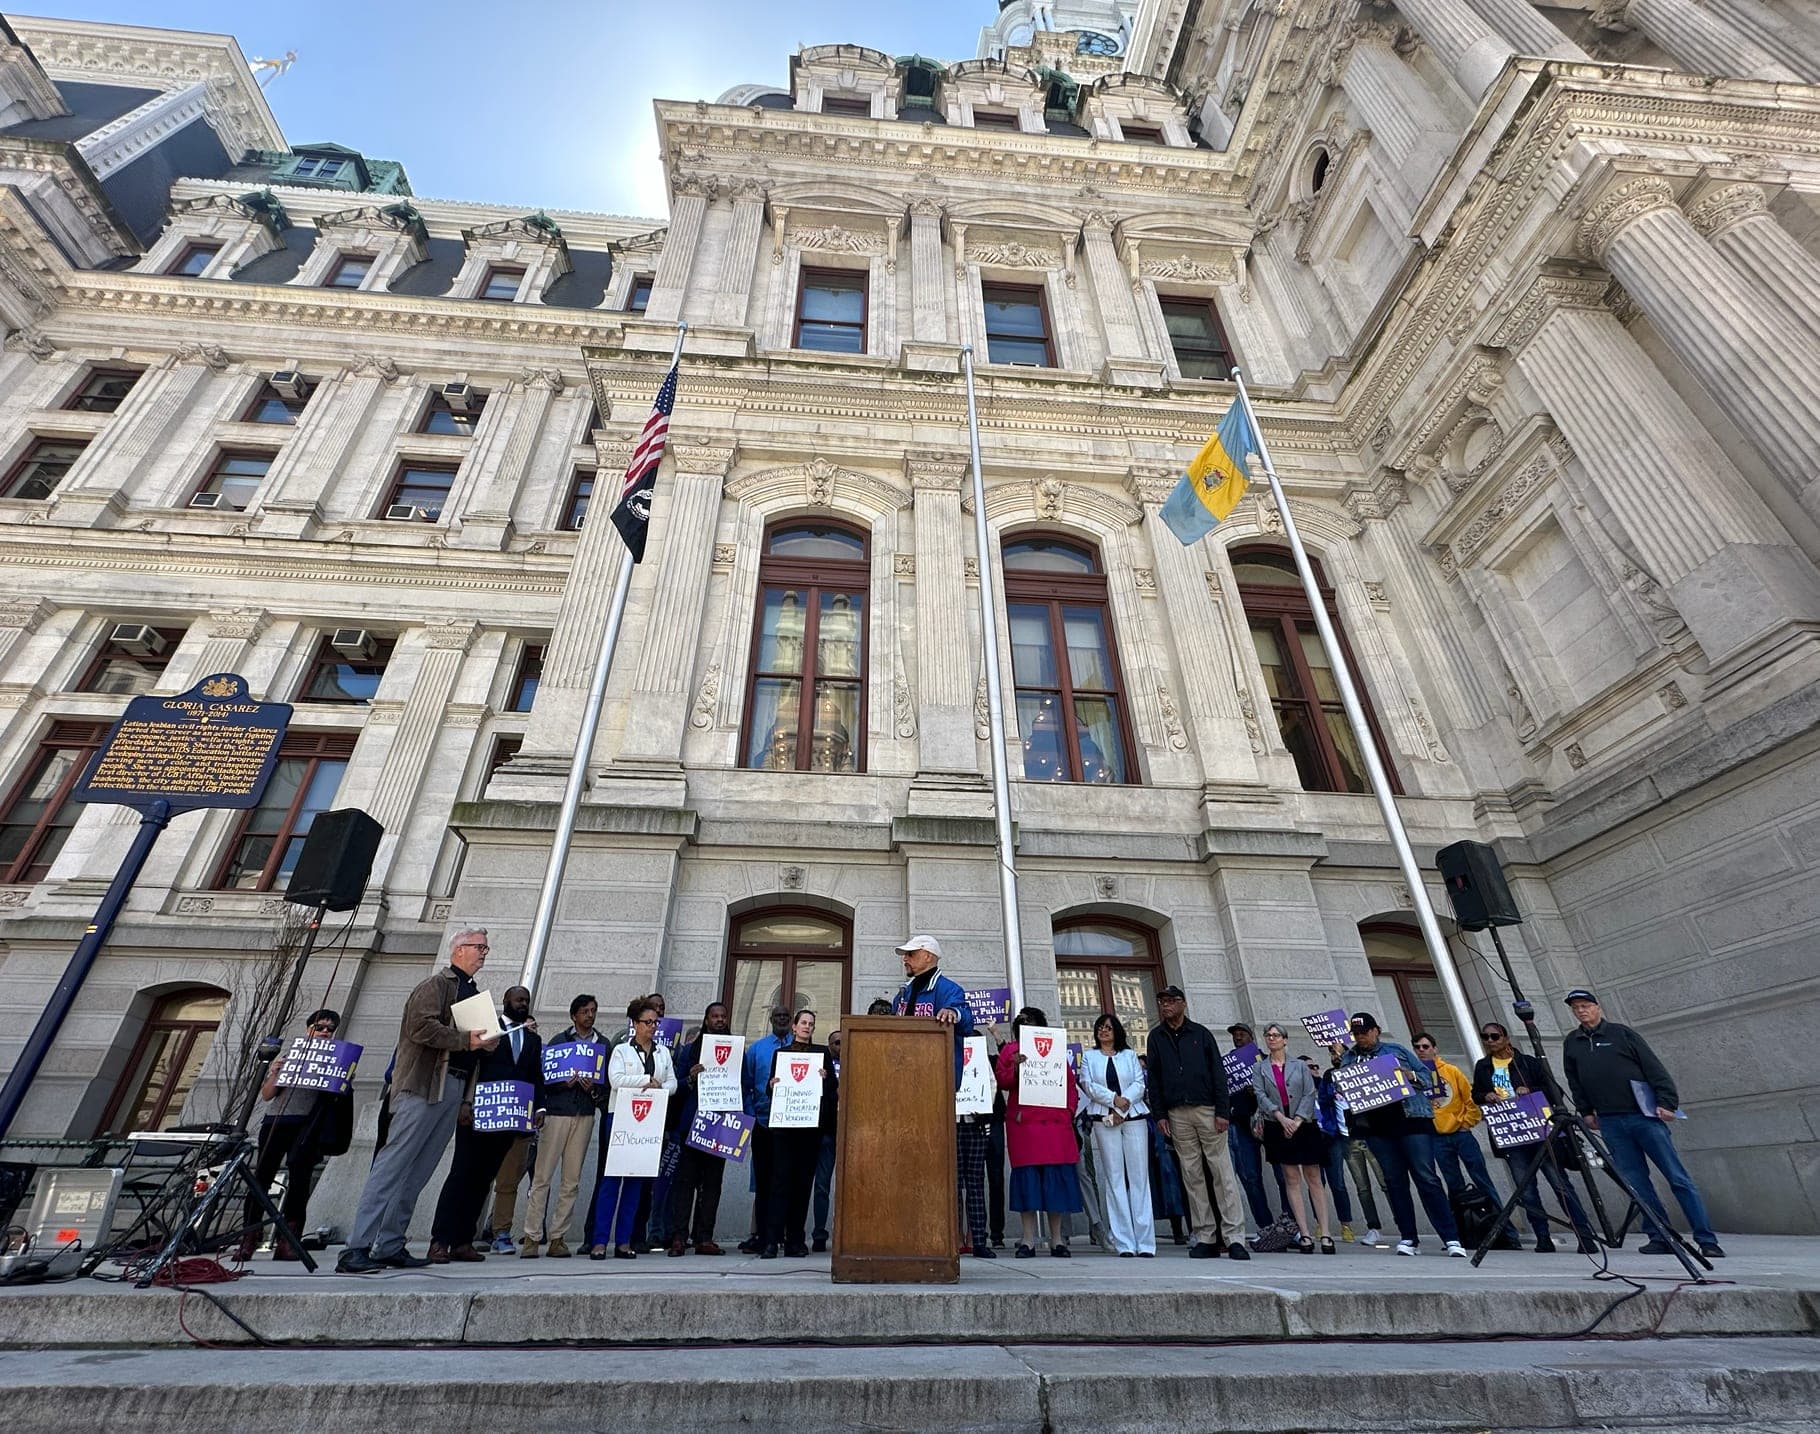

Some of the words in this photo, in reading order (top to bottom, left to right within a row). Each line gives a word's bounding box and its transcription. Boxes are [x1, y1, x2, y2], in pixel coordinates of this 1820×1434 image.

[163, 701, 204, 710] GLORIA
[209, 703, 261, 713] CASAREZ
[149, 721, 176, 729] lesbian
[177, 722, 196, 730] civil
[196, 724, 219, 732] rights
[244, 732, 276, 740] fighting
[113, 738, 154, 746] affordable
[238, 744, 254, 752] Gay
[191, 747, 230, 755] Education
[103, 757, 133, 765] serving
[213, 761, 263, 769] transgender
[106, 750, 145, 759] developing
[185, 754, 228, 762] recognized
[228, 756, 265, 764] programs
[164, 765, 206, 773] appointed
[170, 778, 203, 786] adopted
[219, 780, 254, 788] broadest
[964, 990, 991, 1000] Public
[980, 1006, 1005, 1015] Public
[1302, 1014, 1329, 1026] Public
[1306, 1022, 1336, 1033] Dollars
[1322, 1026, 1348, 1039] Public
[292, 1038, 336, 1051] Public
[287, 1049, 337, 1064] Dollars
[545, 1046, 573, 1061] Say
[575, 1043, 594, 1057] No
[282, 1061, 302, 1072] for
[307, 1063, 347, 1078] Public
[544, 1061, 558, 1071] To
[1224, 1062, 1246, 1075] llars
[1334, 1064, 1369, 1081] Public
[543, 1067, 593, 1081] Vouchers
[1023, 1069, 1035, 1077] ALL
[1233, 1065, 1253, 1081] Publ
[277, 1072, 330, 1088] Schools
[1339, 1073, 1380, 1091] Dollars
[475, 1082, 516, 1095] Public
[1345, 1090, 1362, 1101] for
[1362, 1079, 1399, 1096] Public
[474, 1095, 519, 1107] Dollars
[1349, 1093, 1392, 1113] Schools
[1481, 1100, 1517, 1115] Public
[473, 1108, 493, 1118] for
[496, 1105, 528, 1118] Public
[1485, 1110, 1528, 1126] Dollars
[474, 1118, 519, 1130] Schools
[695, 1118, 707, 1131] To
[722, 1112, 741, 1130] No
[1491, 1125, 1509, 1136] for
[1510, 1116, 1547, 1132] Public
[691, 1130, 733, 1155] Vouchers
[1495, 1130, 1540, 1146] Schools
